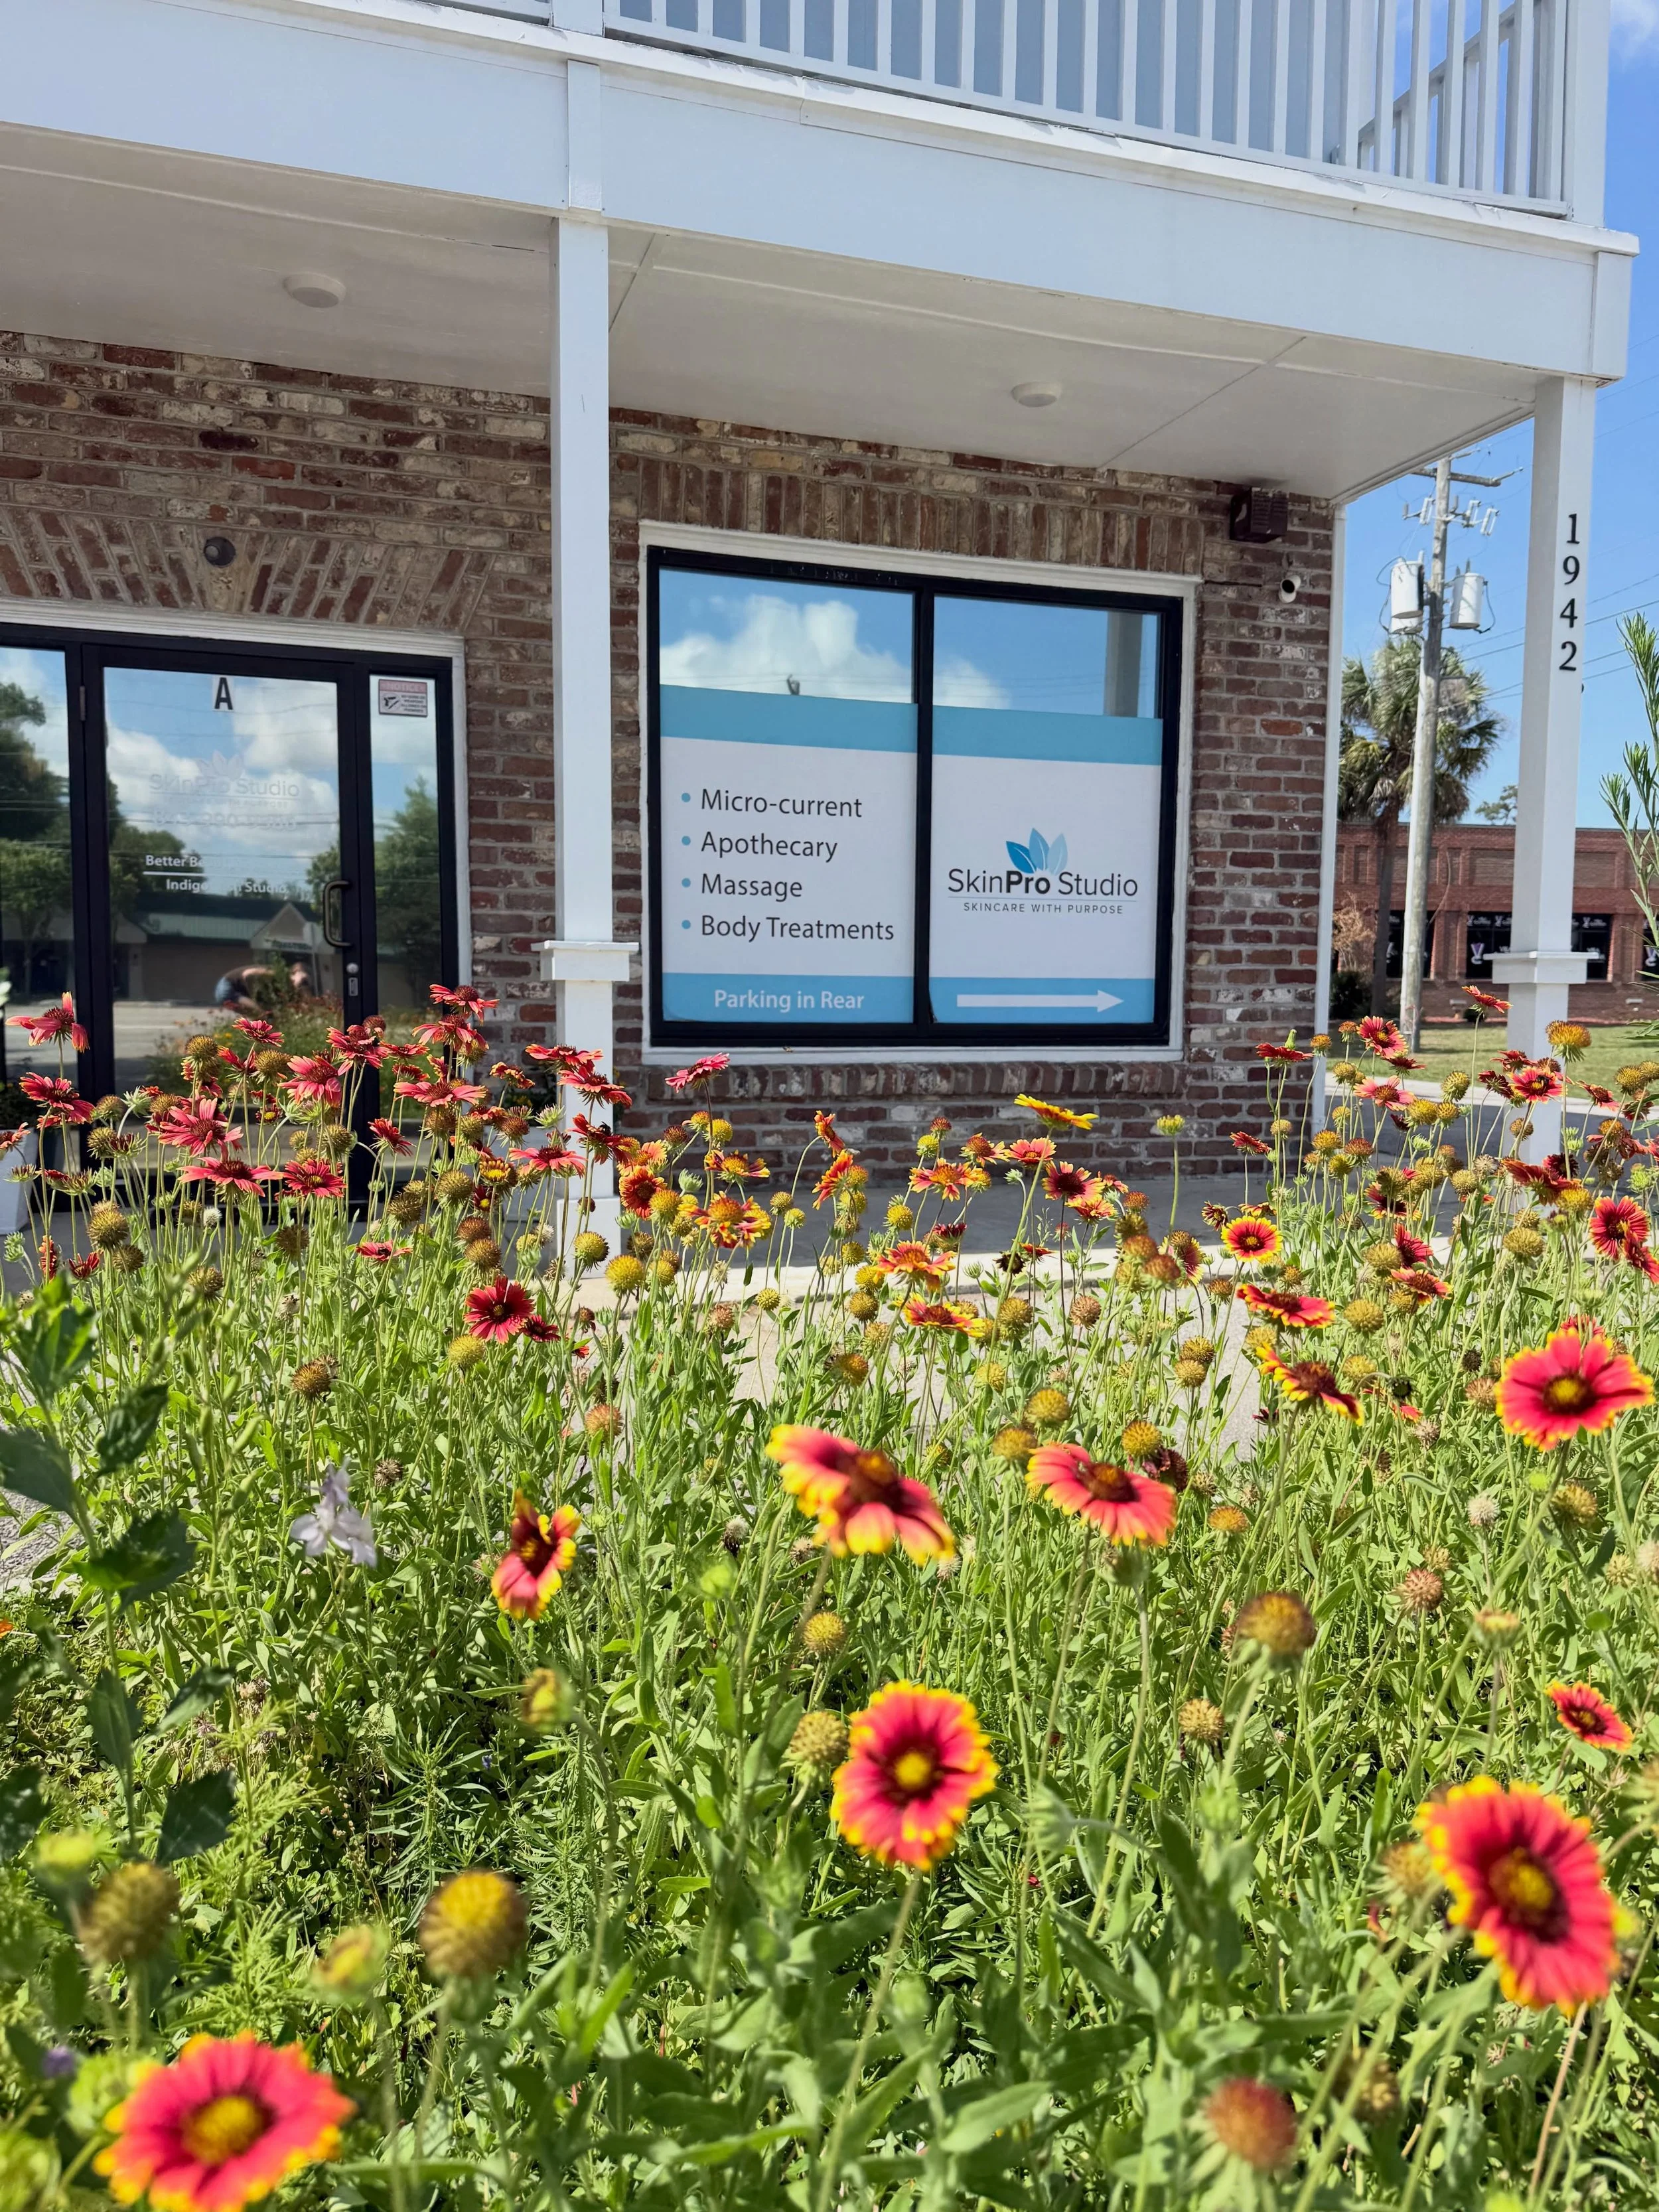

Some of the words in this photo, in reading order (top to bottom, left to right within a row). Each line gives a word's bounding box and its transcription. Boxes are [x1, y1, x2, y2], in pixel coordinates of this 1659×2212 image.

[1559, 514, 1580, 672] 1942
[214, 677, 233, 710] A
[236, 778, 300, 796] Studio
[701, 788, 863, 817] Micro-current
[145, 854, 186, 867] Better
[701, 831, 838, 863] Apothecary
[701, 873, 803, 902] Massage
[948, 868, 1050, 894] SkinPro
[1058, 871, 1138, 897] Studio
[964, 903, 1025, 913] SKINCARE
[1031, 904, 1062, 913] WITH
[1068, 905, 1123, 914] PURPOSE
[701, 915, 760, 942] Body
[766, 917, 895, 940] Treatments
[714, 990, 791, 1013] Parking
[797, 991, 815, 1009] in
[821, 992, 865, 1009] Rear
